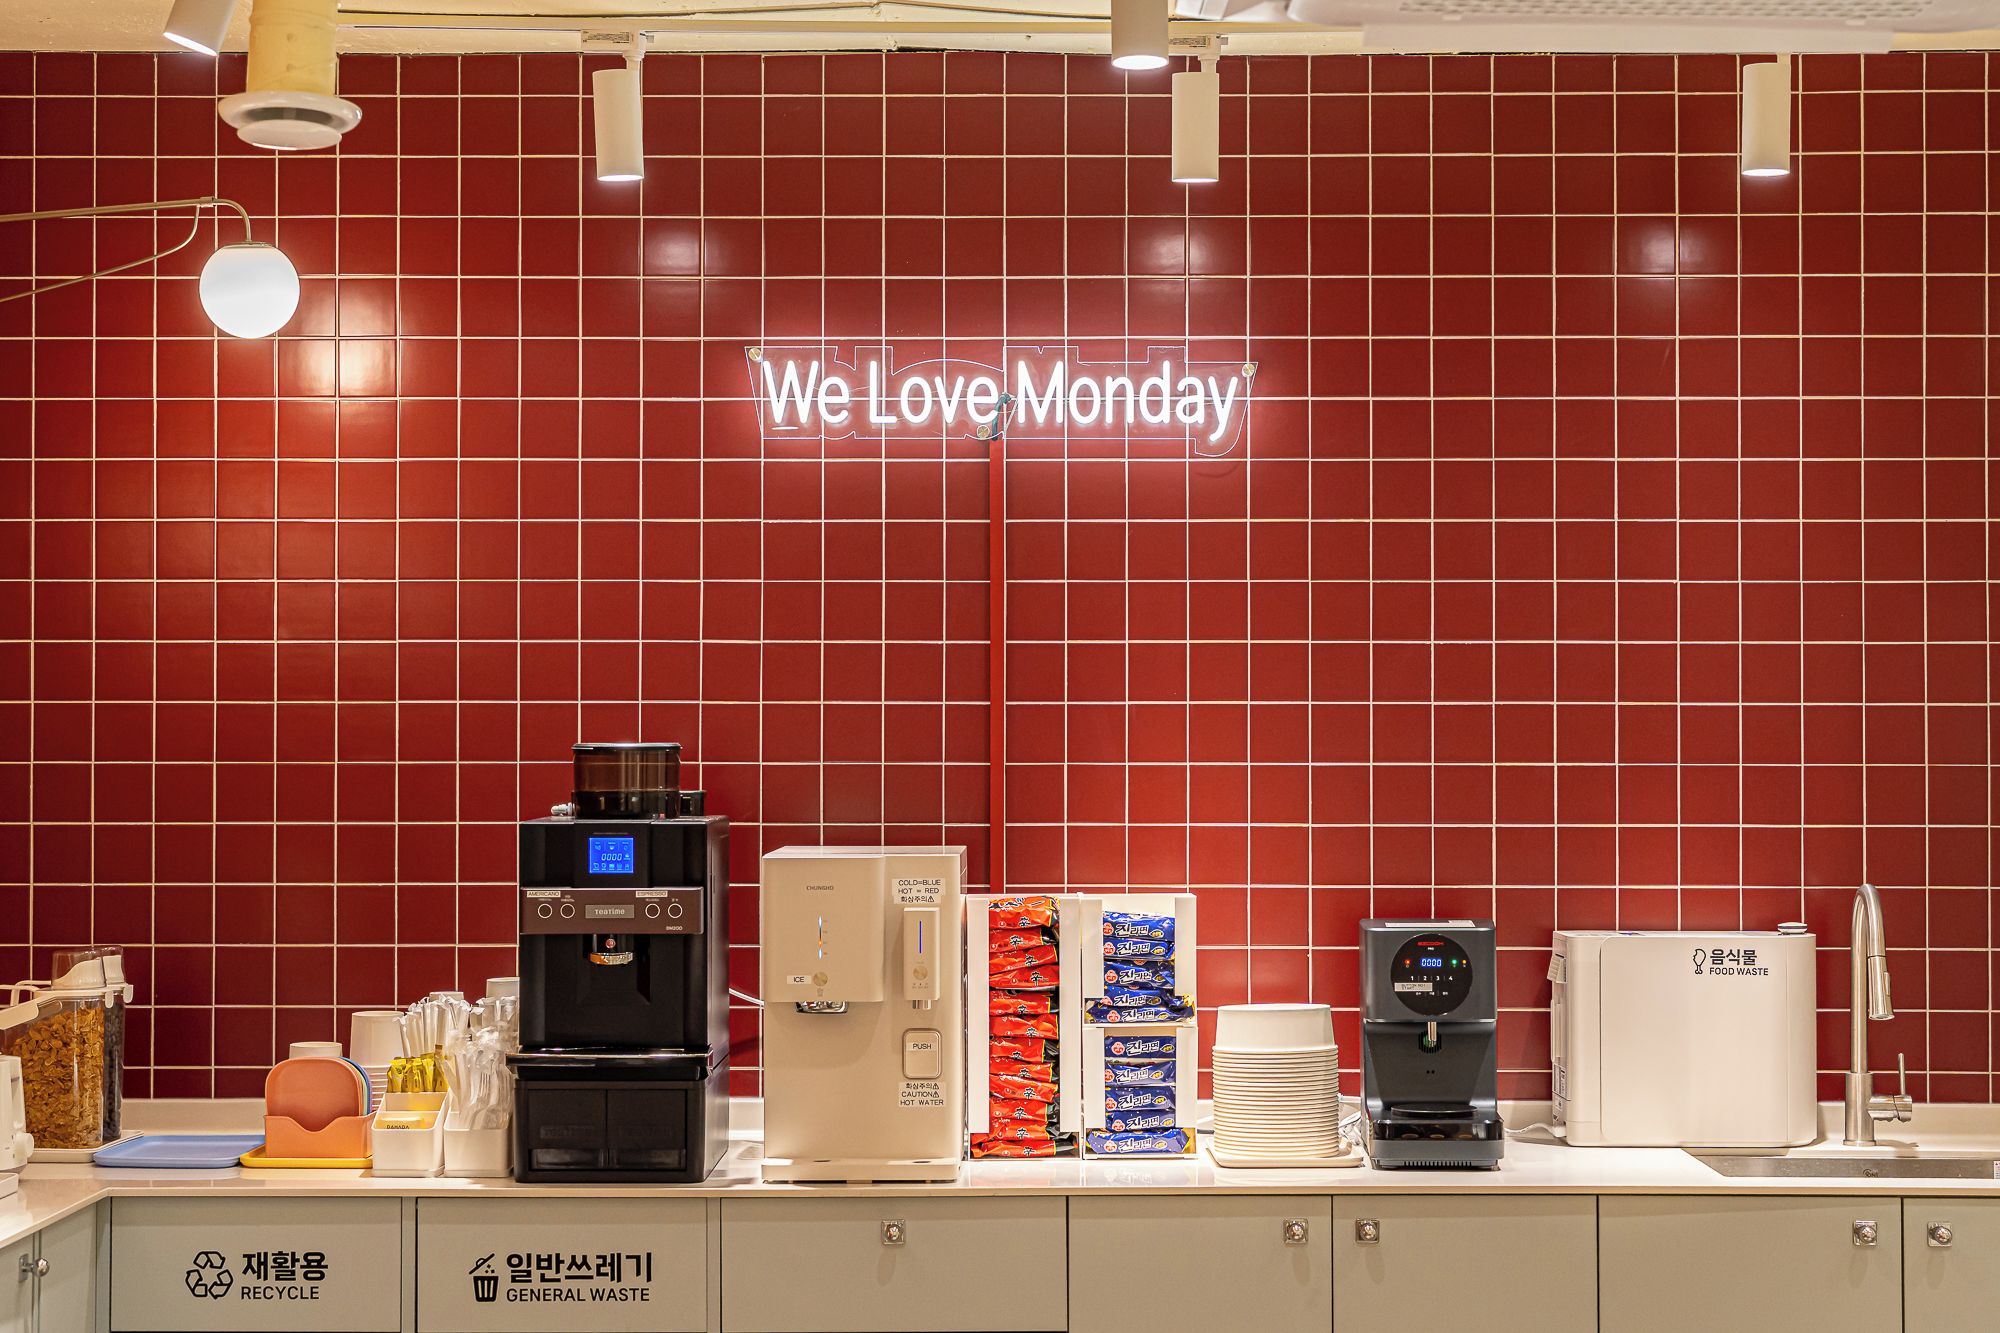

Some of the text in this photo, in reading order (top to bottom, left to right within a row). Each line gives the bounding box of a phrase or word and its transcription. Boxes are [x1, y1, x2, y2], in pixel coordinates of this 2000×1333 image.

[763, 360, 1238, 442] We Love Monday
[602, 853, 622, 861] 0000
[1115, 923, 1148, 937] 진라면
[1117, 941, 1150, 956] 진라면
[1422, 958, 1442, 967] 0000
[1710, 949, 1757, 966] 음식물
[1119, 969, 1152, 984] 진라면
[1710, 968, 1768, 976] FOOD WASTE
[1126, 1040, 1160, 1056] 진라면
[1116, 1069, 1148, 1084] 진라면
[1118, 1094, 1152, 1110] 진라면
[1118, 1138, 1152, 1152] 진라면
[241, 1250, 328, 1282] 재활용
[506, 1252, 653, 1284] 일반쓰레기
[241, 1286, 319, 1300] RECYCLE
[506, 1288, 650, 1302] GENERAL WASTE
